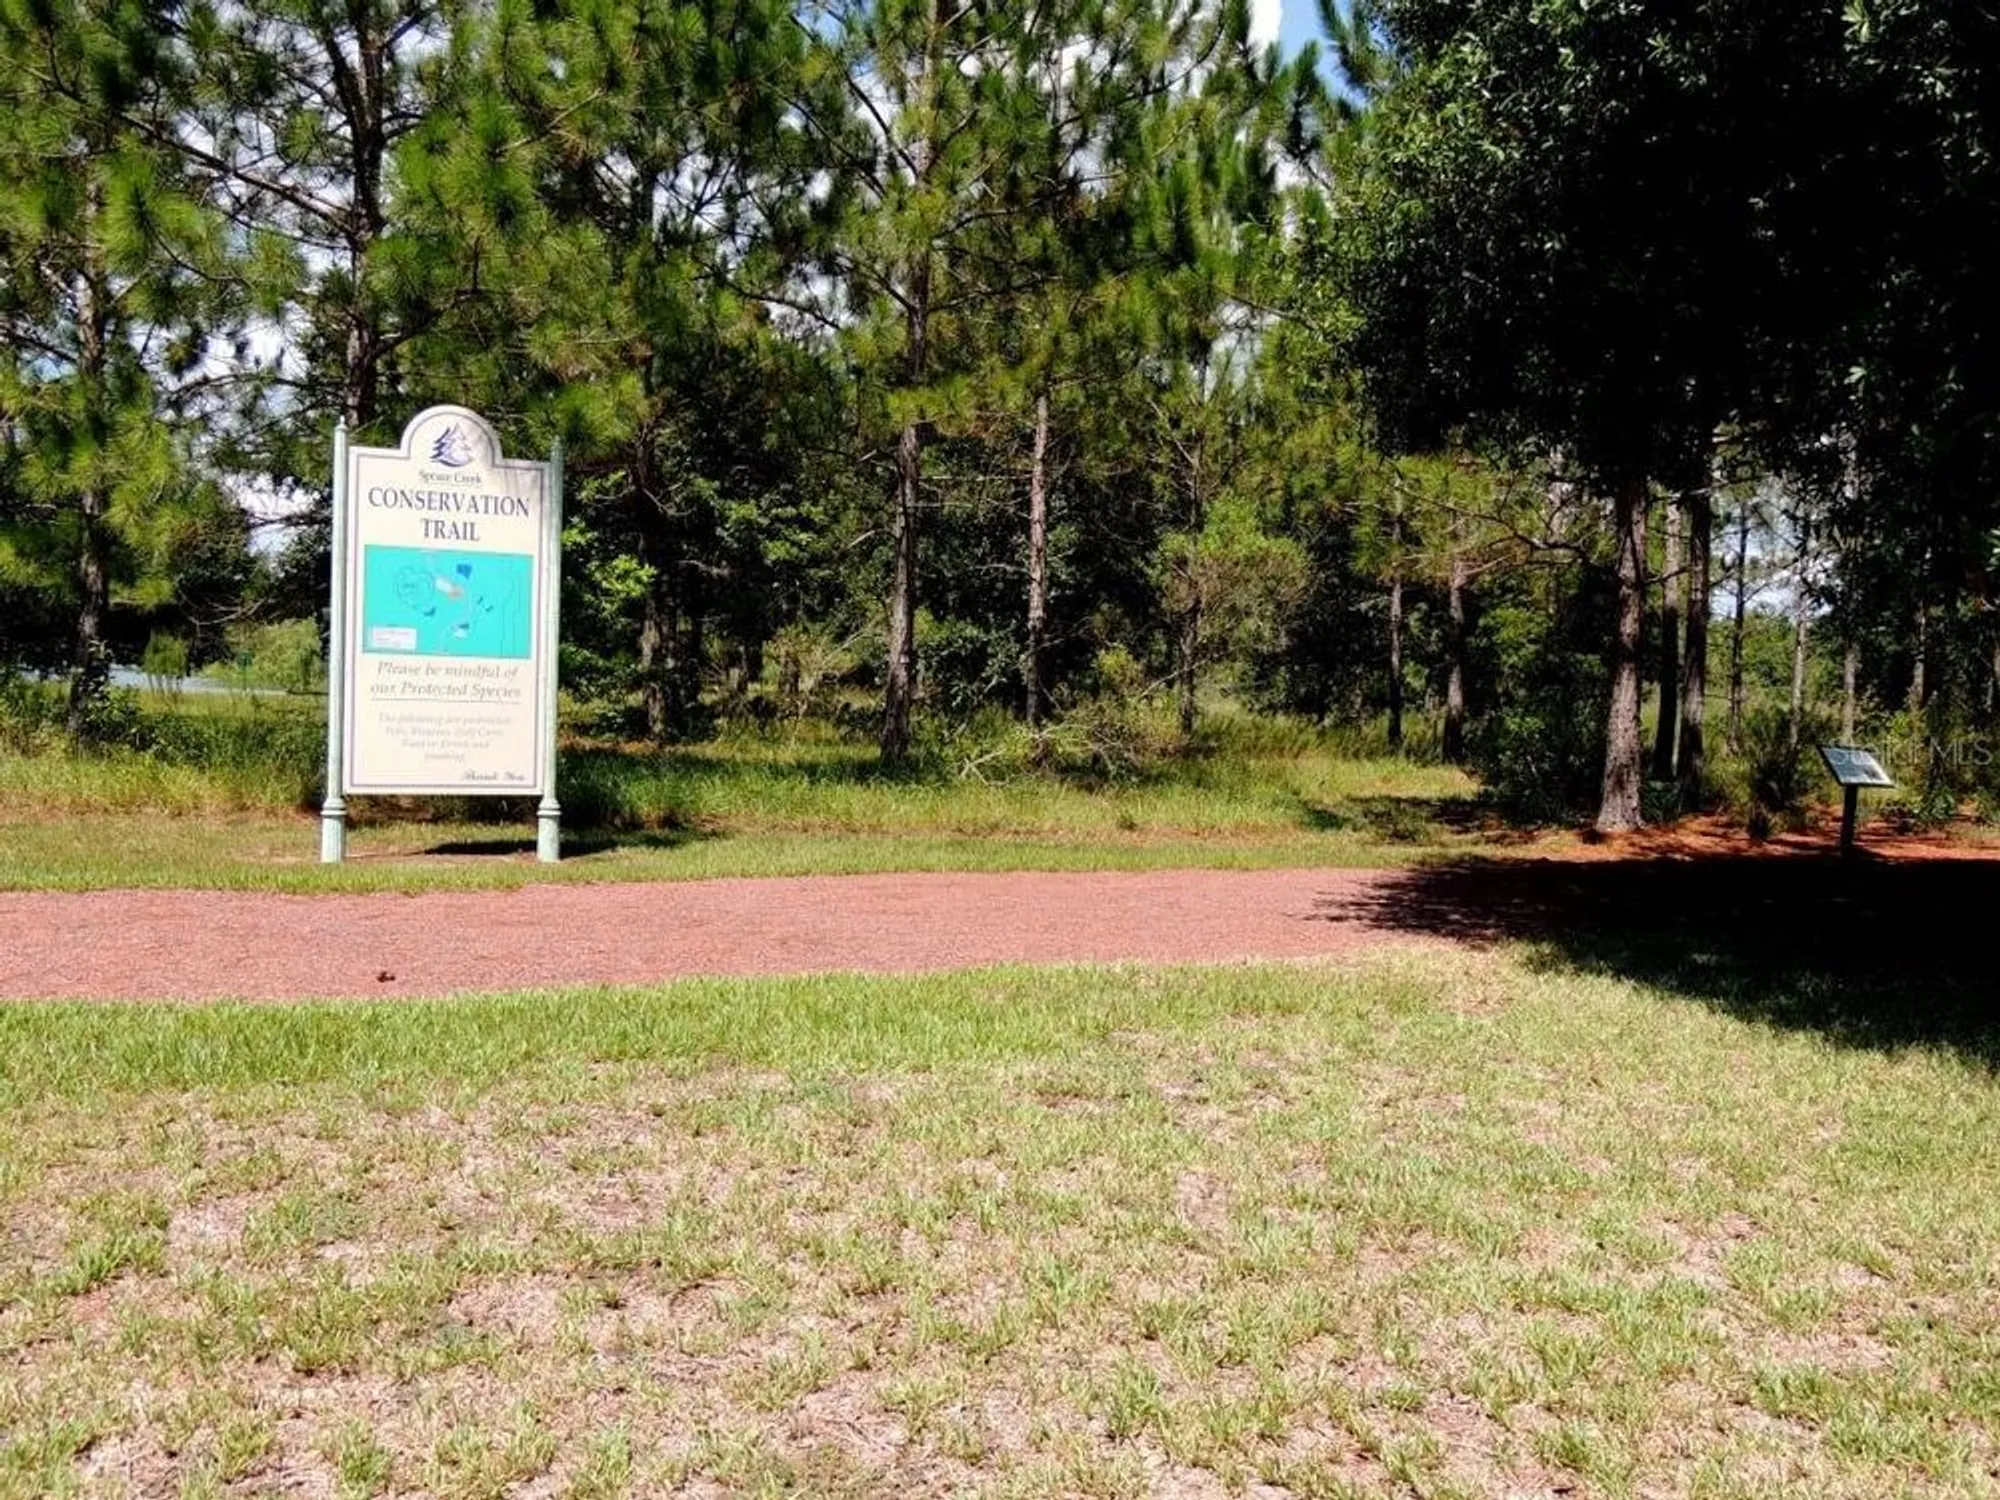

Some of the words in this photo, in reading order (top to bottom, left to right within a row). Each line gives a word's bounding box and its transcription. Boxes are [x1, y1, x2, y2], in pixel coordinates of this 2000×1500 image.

[453, 471, 482, 485] Creek
[368, 486, 530, 517] CONSERVATION
[420, 518, 481, 541] TRAIL
[377, 661, 421, 676] Please
[425, 662, 444, 677] be
[444, 664, 500, 679] mindful
[503, 666, 518, 680] of
[370, 683, 396, 694] our
[400, 681, 468, 697] Protected
[472, 683, 522, 700] Species
